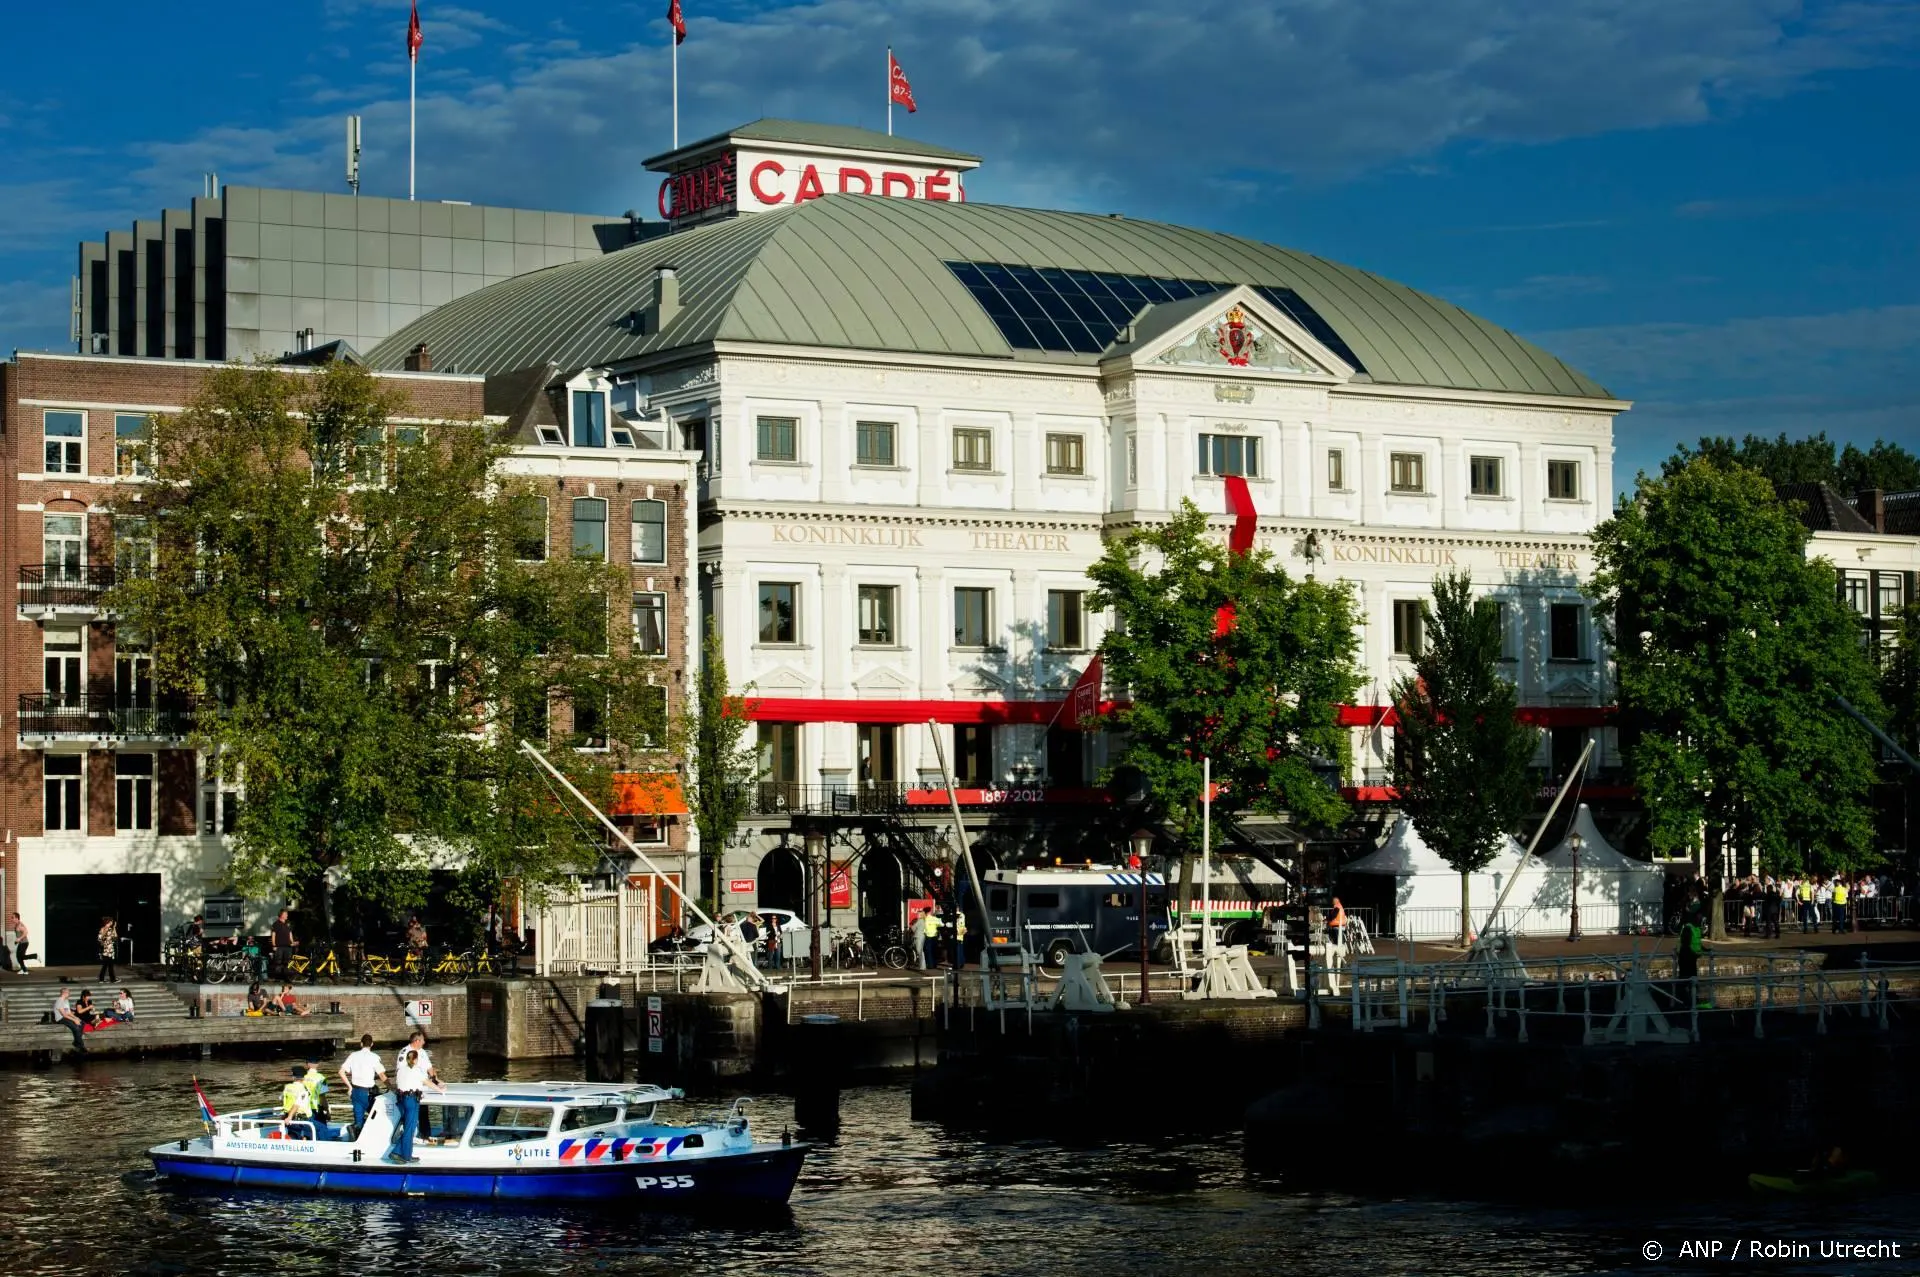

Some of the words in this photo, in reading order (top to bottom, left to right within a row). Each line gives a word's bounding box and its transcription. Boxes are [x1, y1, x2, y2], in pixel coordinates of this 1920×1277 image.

[771, 524, 924, 549] KONINKLIJK
[968, 530, 1071, 551] THEATER
[1332, 545, 1458, 568] KONINKLIJK
[1494, 550, 1579, 570] THEATER
[732, 881, 752, 891] Galerij
[226, 1141, 268, 1150] AMSTERDAM
[270, 1143, 315, 1152] AMSTELLAND
[508, 1147, 551, 1160] POLITIE
[635, 1175, 695, 1190] P55
